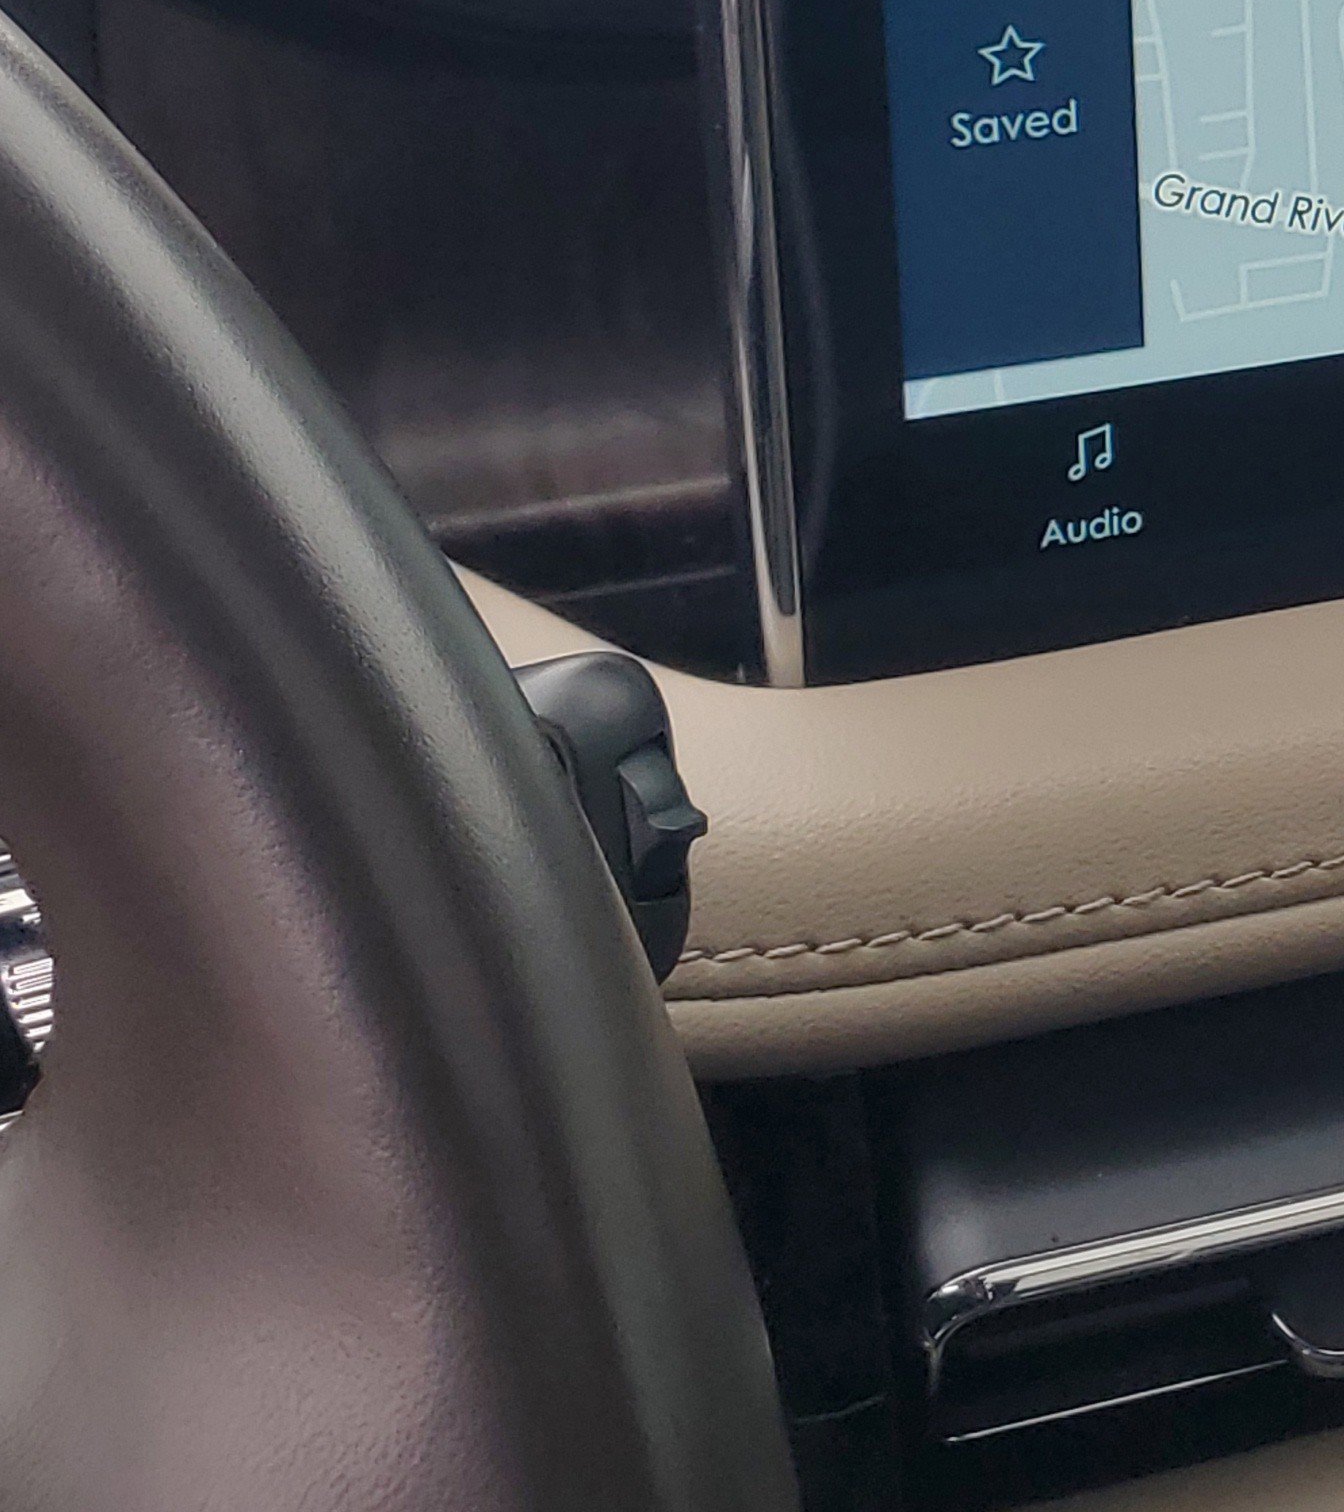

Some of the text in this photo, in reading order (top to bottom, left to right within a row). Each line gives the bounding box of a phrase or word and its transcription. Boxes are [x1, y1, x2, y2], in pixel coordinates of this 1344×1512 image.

[949, 99, 1079, 149] Saved
[1153, 173, 1280, 226] Grand
[1039, 507, 1143, 550] Audio
